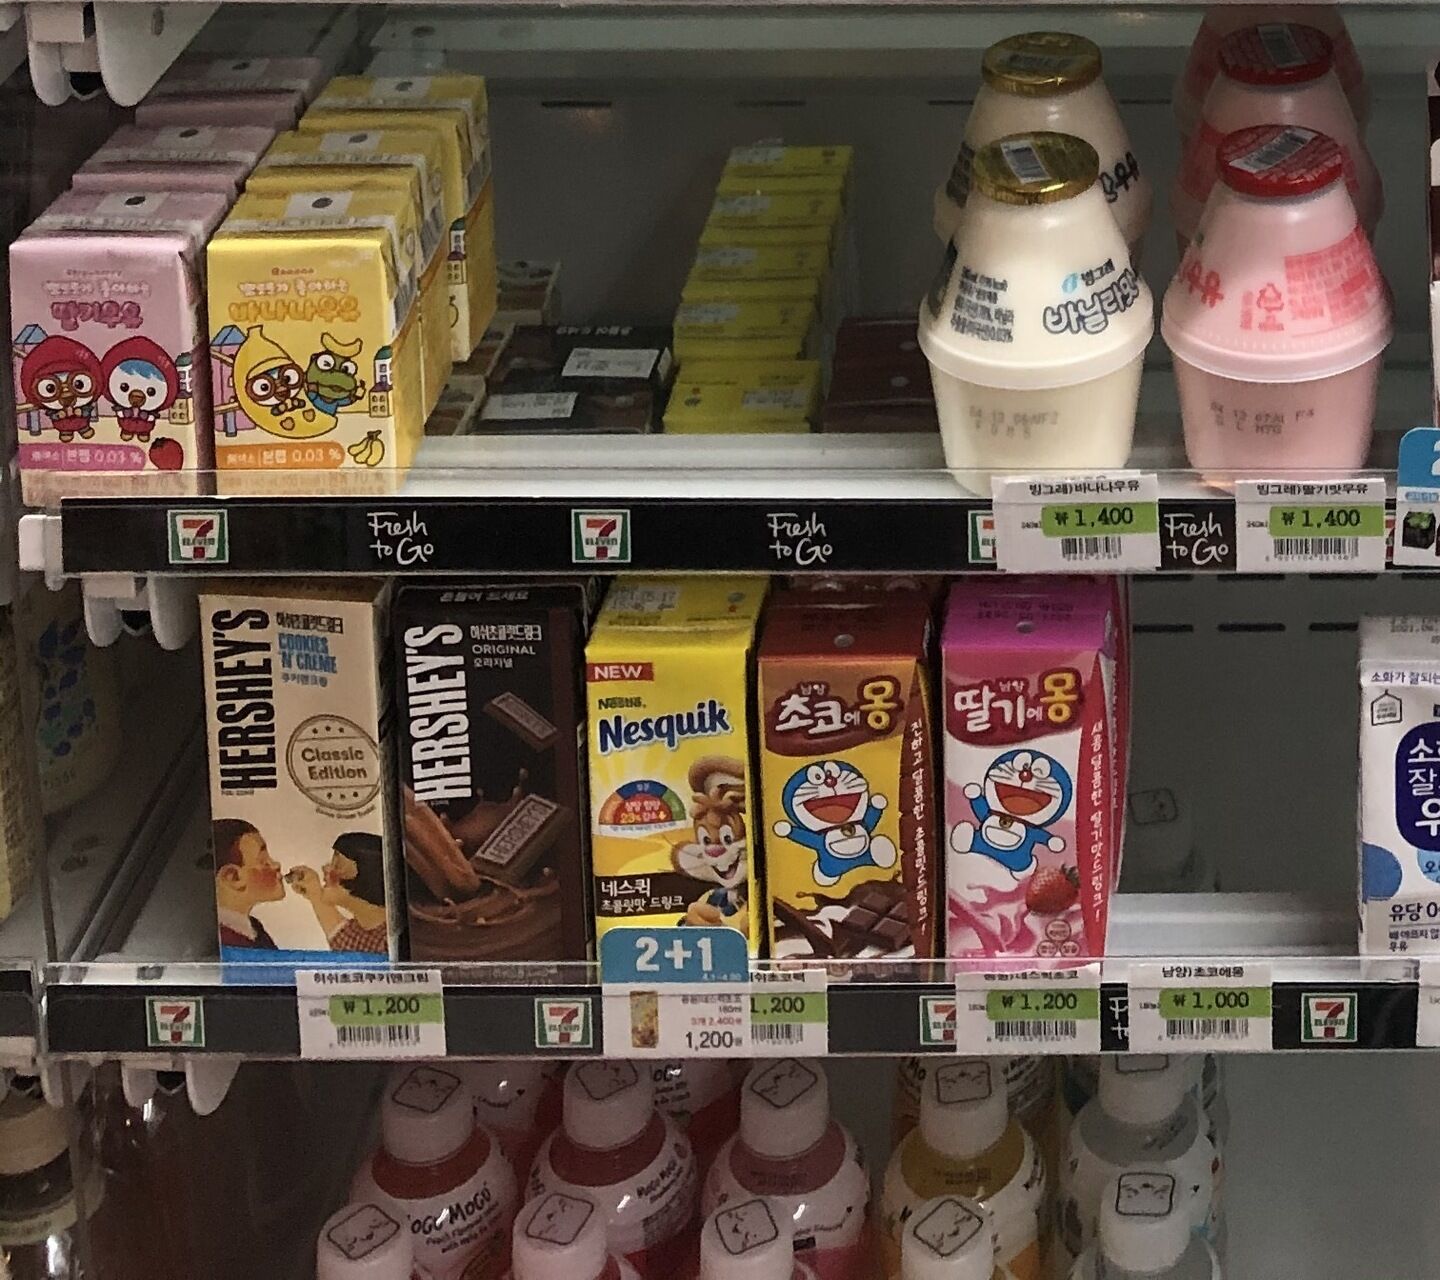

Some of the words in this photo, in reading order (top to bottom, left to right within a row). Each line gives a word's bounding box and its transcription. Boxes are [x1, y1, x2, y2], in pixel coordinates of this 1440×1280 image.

[367, 512, 427, 538] Fresh
[1074, 508, 1133, 528] 1,400
[370, 542, 393, 557] to
[397, 540, 434, 565] Go
[472, 644, 536, 656] ORIGINAL
[594, 665, 644, 679] NEW
[212, 608, 278, 791] HERSHEY'S
[404, 623, 473, 801] HERSHEY'S
[598, 703, 732, 753] Nesquik
[300, 746, 365, 764] Classic
[307, 764, 368, 781] Edition
[601, 879, 651, 899] 네스퀵
[1388, 901, 1423, 922] 유당
